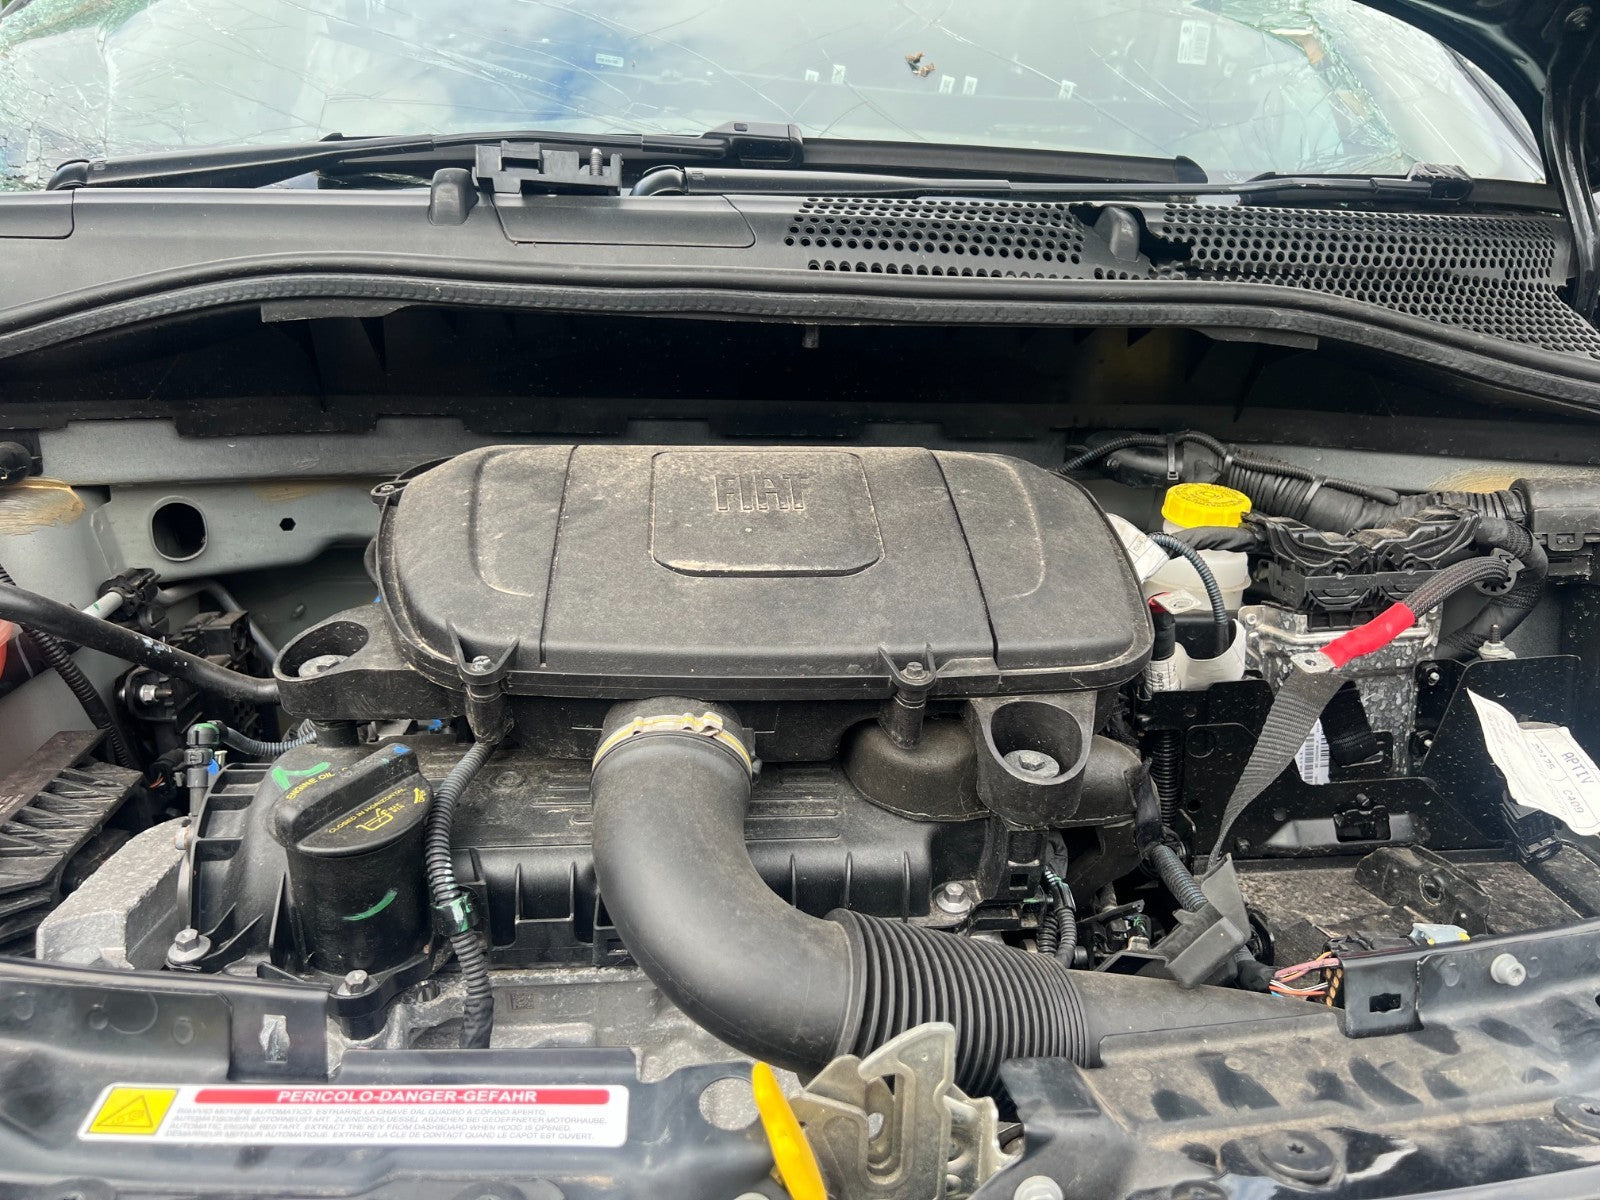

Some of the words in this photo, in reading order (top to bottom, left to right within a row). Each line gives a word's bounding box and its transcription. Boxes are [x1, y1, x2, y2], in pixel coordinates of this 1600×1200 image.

[714, 472, 809, 512] FIAT
[1560, 752, 1595, 785] APTIV
[286, 777, 318, 800] ENGINE
[318, 771, 335, 780] OIL
[276, 1090, 538, 1103] PERICOLO-DANGER-GEFAHR
